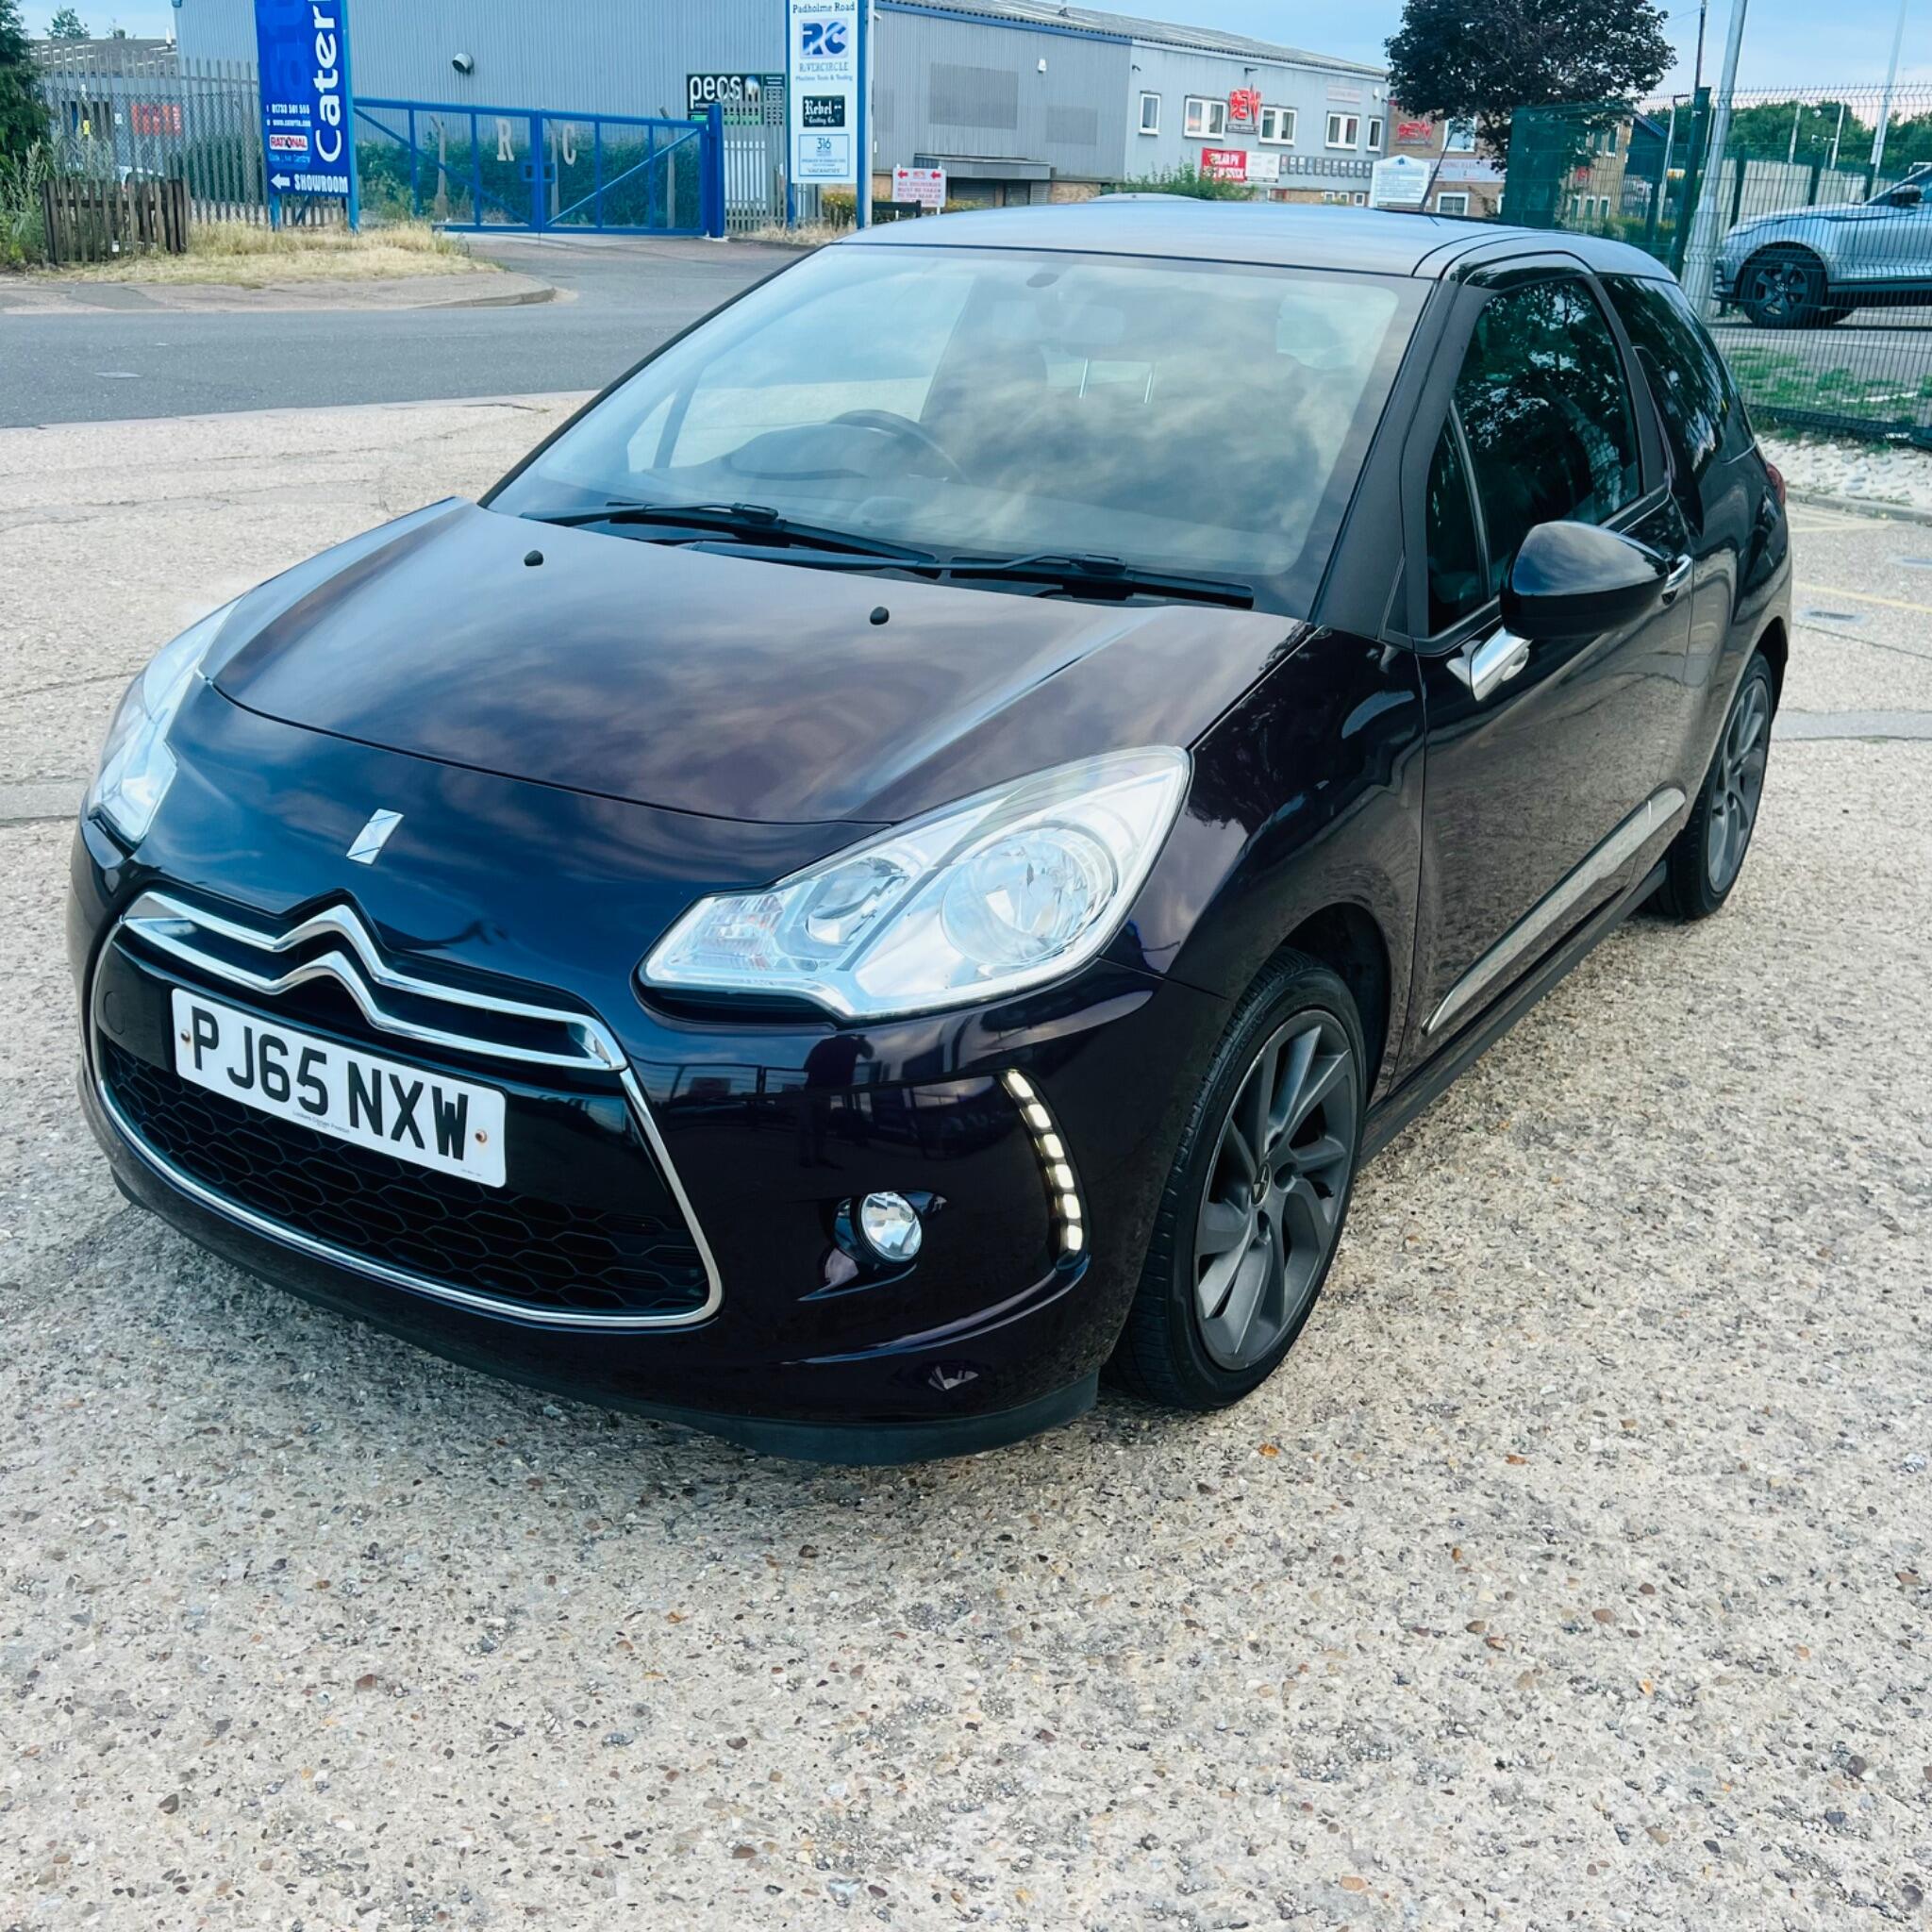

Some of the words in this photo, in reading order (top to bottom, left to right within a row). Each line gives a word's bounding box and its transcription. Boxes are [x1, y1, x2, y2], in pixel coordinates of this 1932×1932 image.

[792, 3, 832, 13] Padholme
[834, 2, 856, 12] Road
[307, 0, 342, 162] Cater
[804, 99, 833, 115] Rebel
[271, 136, 307, 148] RATIONAL
[496, 118, 515, 162] R
[561, 124, 577, 165] C
[293, 174, 350, 194] SHOWROOM
[191, 1005, 329, 1117] PJ65
[347, 1060, 469, 1161] NXW
